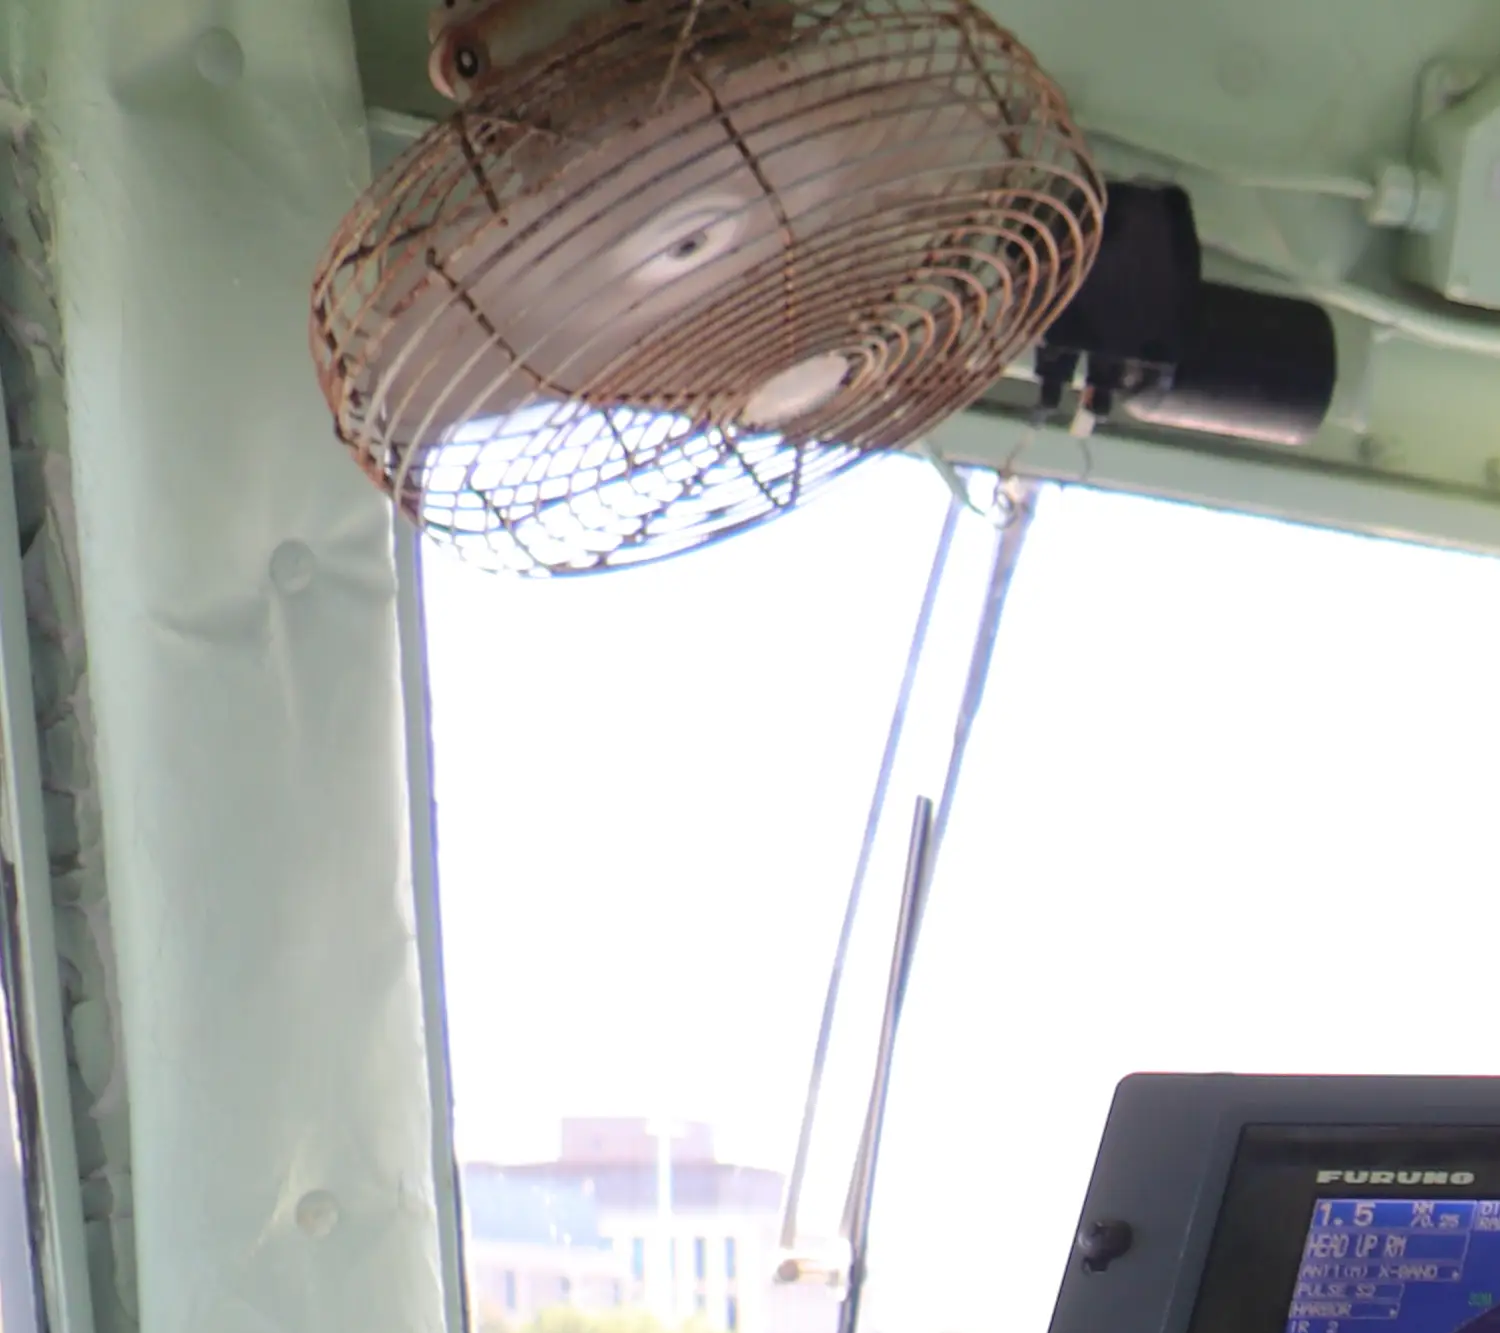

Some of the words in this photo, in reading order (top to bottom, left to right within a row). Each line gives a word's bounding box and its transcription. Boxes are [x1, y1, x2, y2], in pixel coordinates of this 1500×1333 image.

[1316, 1170, 1475, 1185] FURUNO
[1319, 1202, 1376, 1227] 1.5
[1355, 1234, 1378, 1257] UP
[1297, 1283, 1349, 1298] PULSE
